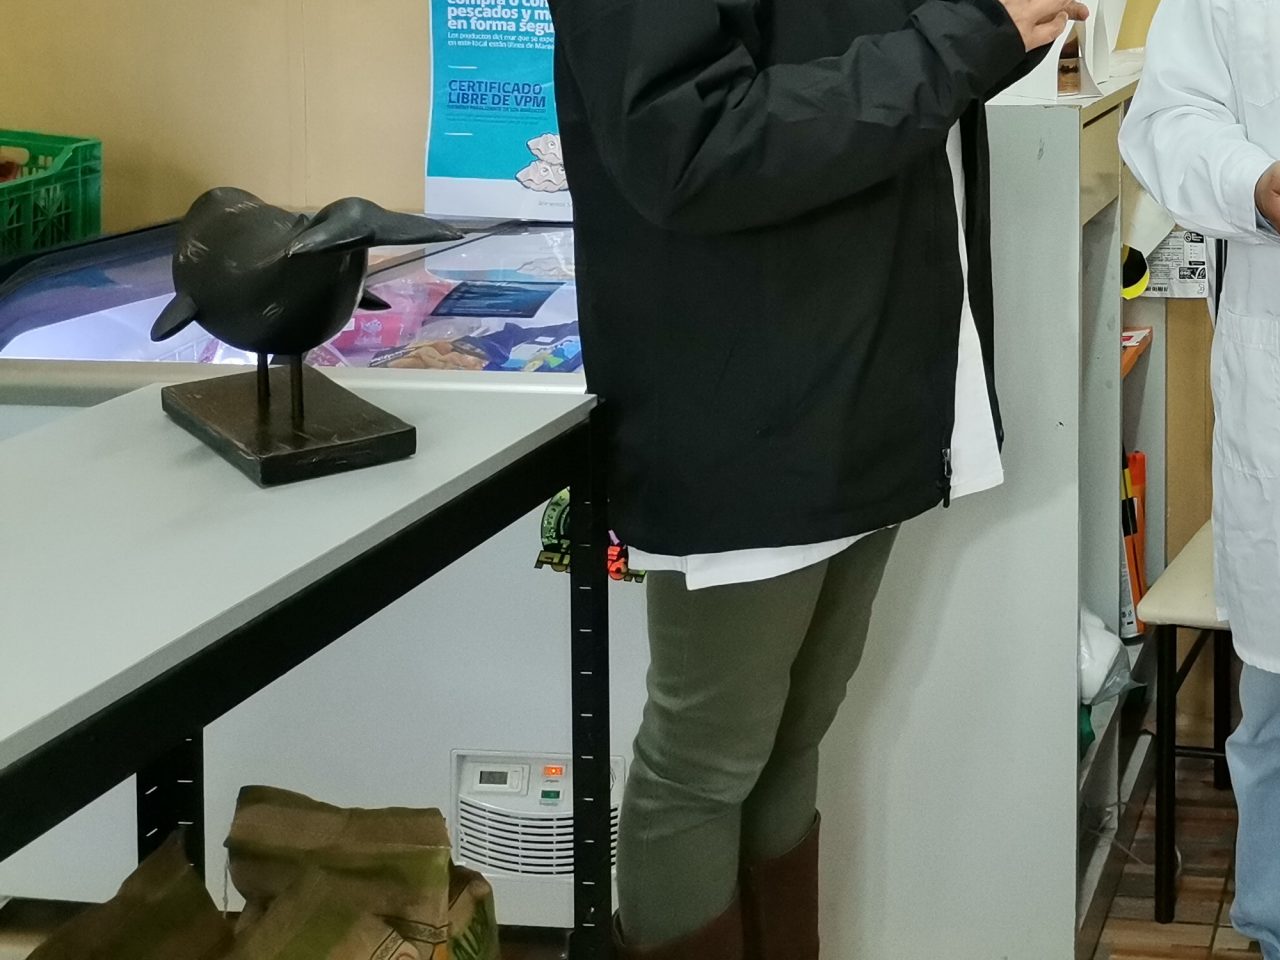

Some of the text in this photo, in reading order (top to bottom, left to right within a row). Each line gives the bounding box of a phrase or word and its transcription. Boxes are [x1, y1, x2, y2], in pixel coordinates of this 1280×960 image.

[447, 6, 518, 20] pescados
[521, 9, 531, 23] y
[447, 17, 554, 36] en forma segu
[448, 80, 543, 95] CERTIFICADO
[448, 93, 546, 108] LIBRE DE VPM
